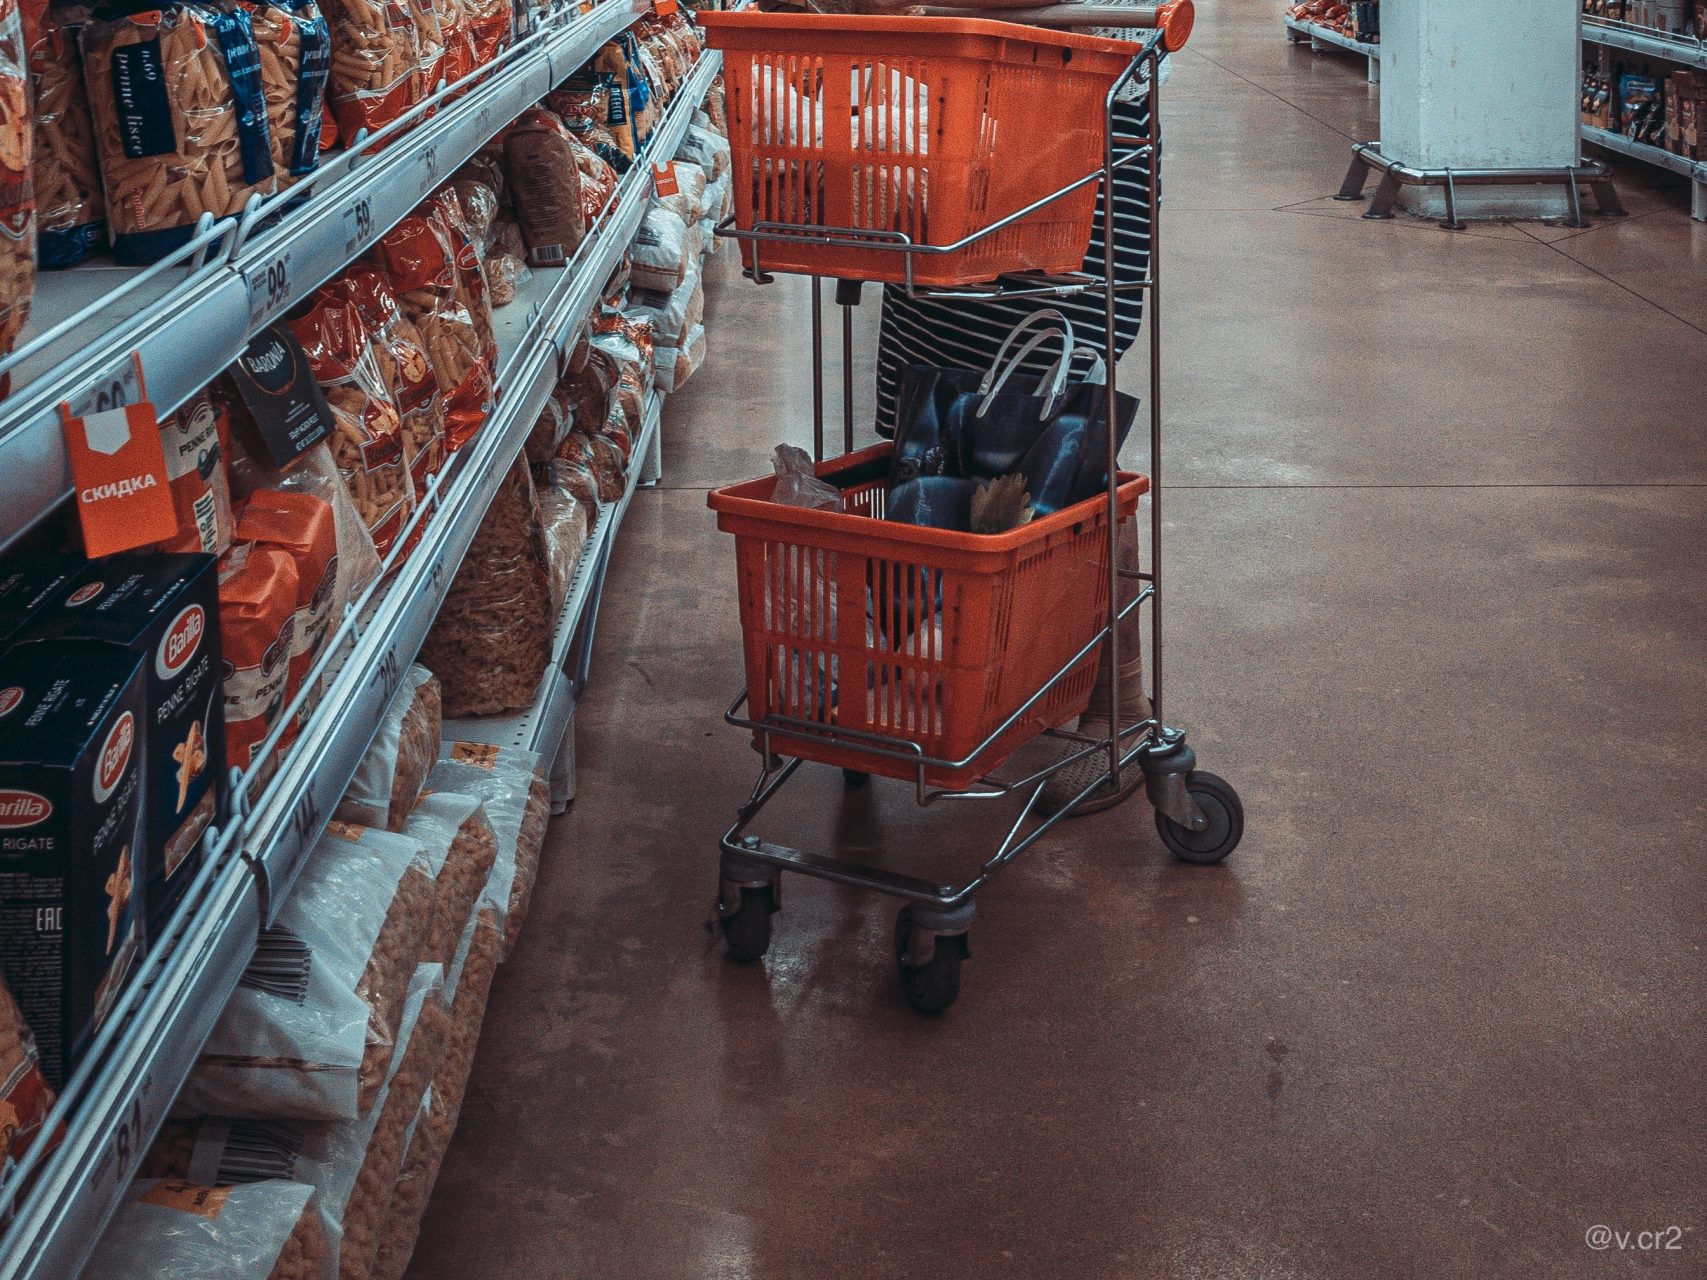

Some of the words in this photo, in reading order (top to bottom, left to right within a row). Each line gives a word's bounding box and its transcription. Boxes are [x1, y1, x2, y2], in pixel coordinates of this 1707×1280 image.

[141, 50, 157, 81] n.69
[116, 52, 135, 105] penne
[127, 114, 144, 156] lisce
[355, 200, 370, 242] 59
[266, 259, 286, 311] 99
[247, 340, 286, 373] BARONIA
[81, 473, 158, 504] СКИДКА
[167, 612, 202, 664] Barilla
[47, 679, 71, 704] RIGATE
[157, 684, 185, 724] PENNE
[184, 654, 210, 695] RIGATE
[0, 797, 44, 817] arilla
[3, 837, 55, 850] RIGATE
[36, 907, 63, 931] EAC
